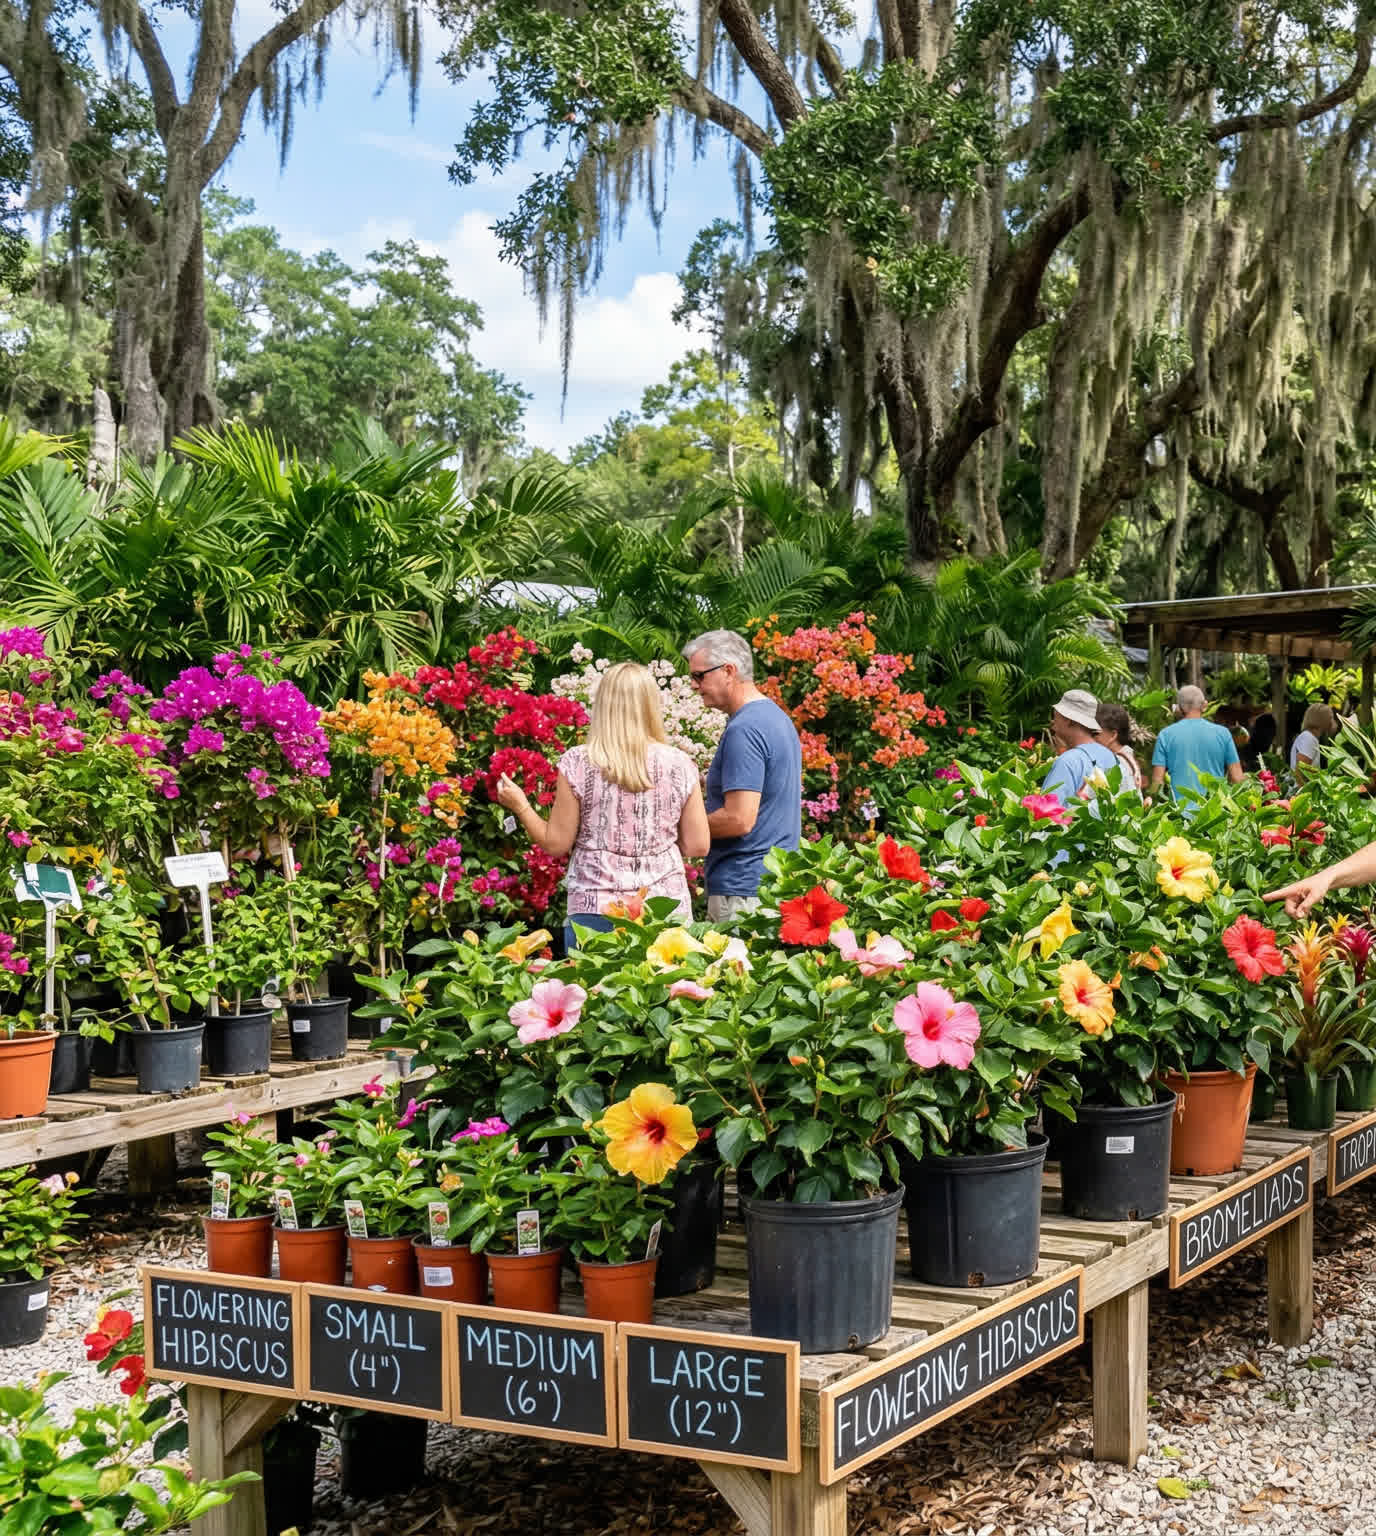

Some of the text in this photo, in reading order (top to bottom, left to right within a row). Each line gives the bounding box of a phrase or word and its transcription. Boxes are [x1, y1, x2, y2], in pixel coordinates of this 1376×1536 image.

[1186, 1165, 1305, 1266] BROMELIADS
[156, 1285, 290, 1332] FLOWERING
[324, 1303, 426, 1351] SMALL
[162, 1327, 288, 1379] HIBISCUS
[348, 1348, 402, 1395] (4")
[466, 1324, 598, 1381] MEDIUM
[649, 1345, 765, 1398] LARGE
[838, 1289, 1076, 1457] FLOWERING HIBISCUS
[504, 1374, 562, 1423] (6")
[668, 1393, 744, 1444] (12")
